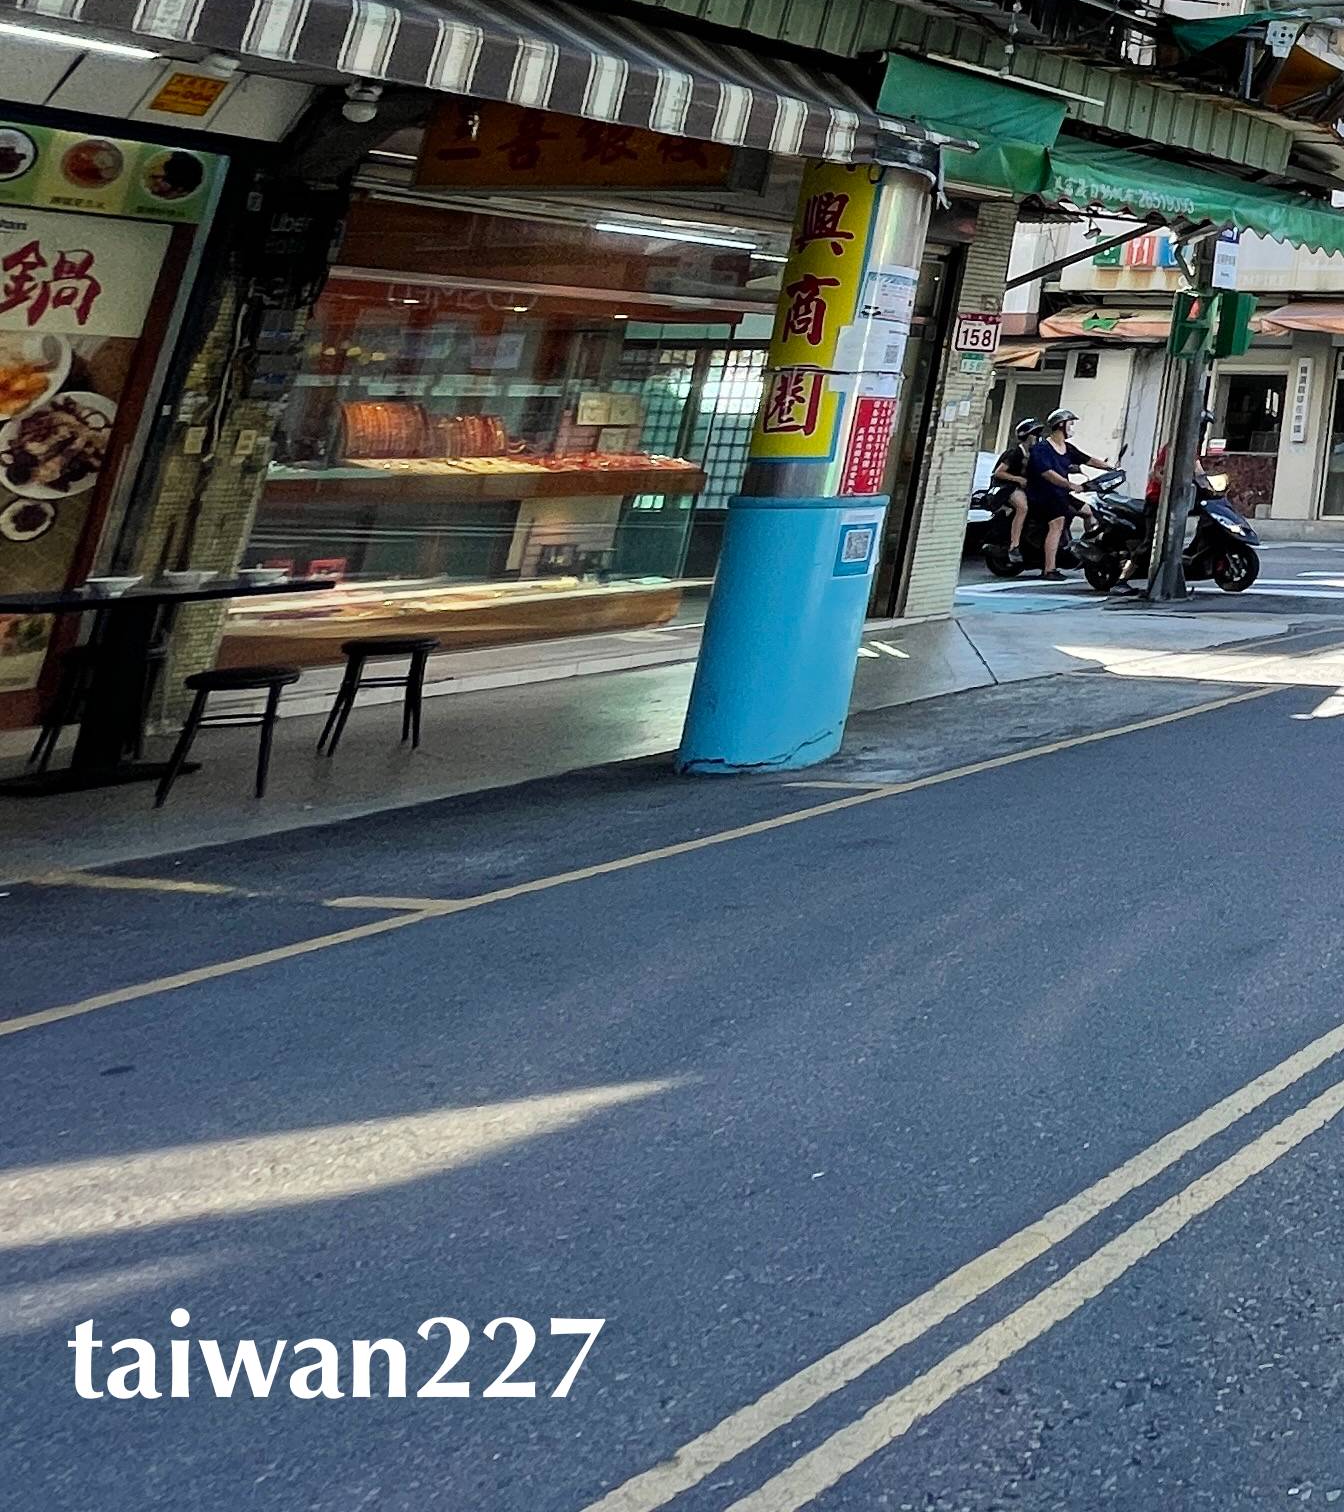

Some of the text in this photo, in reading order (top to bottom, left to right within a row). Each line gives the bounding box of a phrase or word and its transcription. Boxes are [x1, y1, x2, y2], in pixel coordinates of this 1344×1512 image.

[0, 240, 102, 327] 鍋
[763, 160, 858, 436] 興商圈
[962, 328, 992, 347] 158
